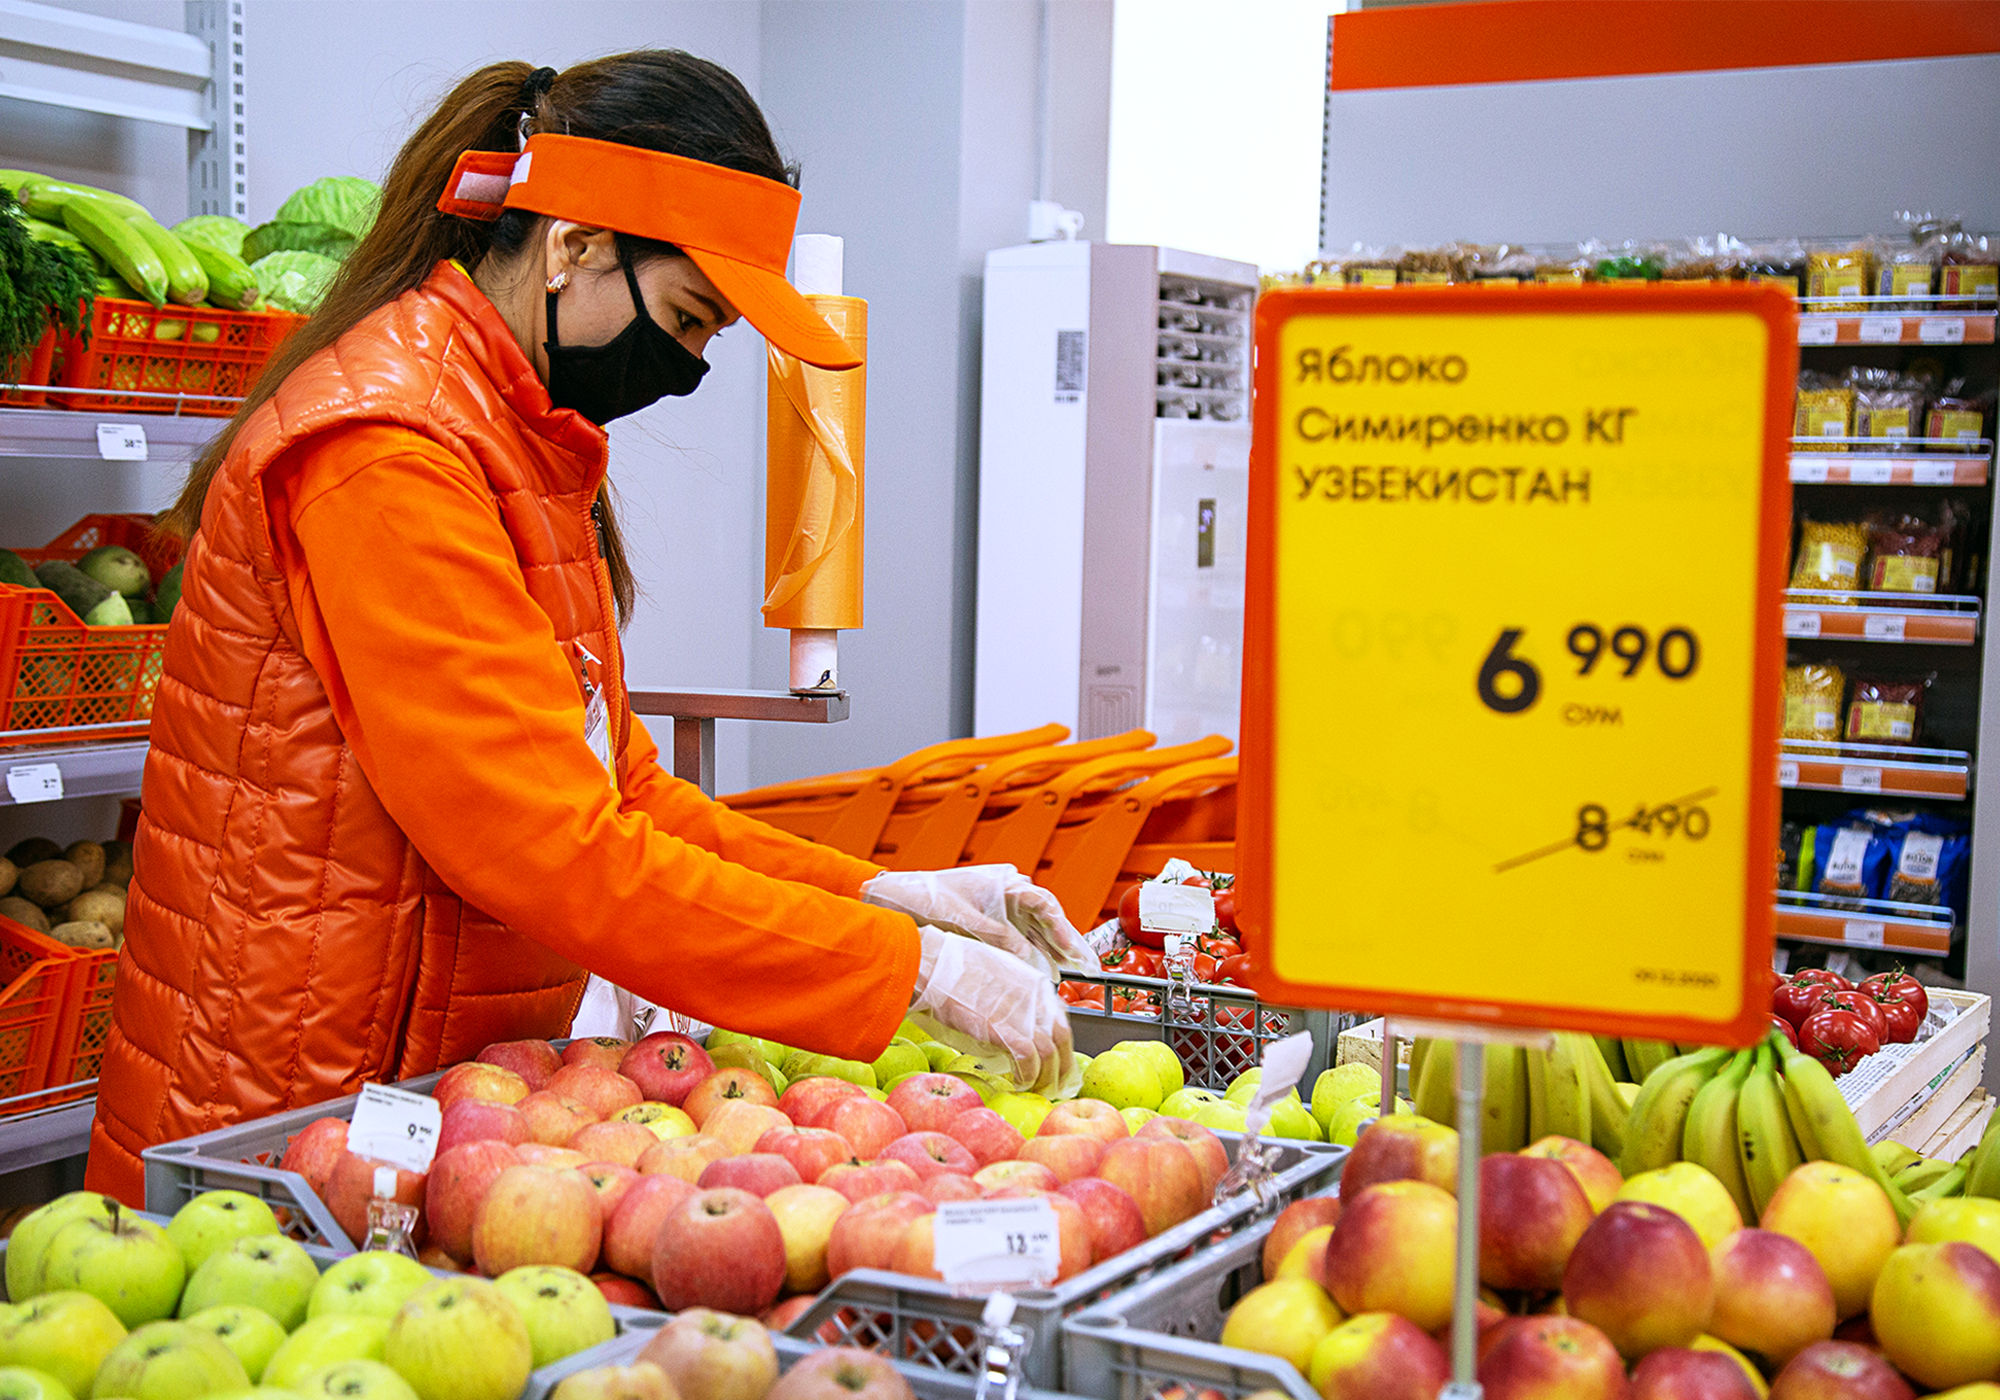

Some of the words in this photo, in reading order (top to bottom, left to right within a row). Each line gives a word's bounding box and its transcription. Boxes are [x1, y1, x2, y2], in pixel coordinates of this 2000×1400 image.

[1297, 346, 1468, 384] Яблоко
[1297, 406, 1570, 450] Симиренко
[1586, 407, 1639, 444] КГ
[1296, 465, 1592, 503] УЗБЕКИСТАН
[1477, 626, 1542, 714] 6
[1566, 624, 1700, 678] 990
[1576, 803, 1608, 852] 8
[1627, 803, 1710, 842] 490
